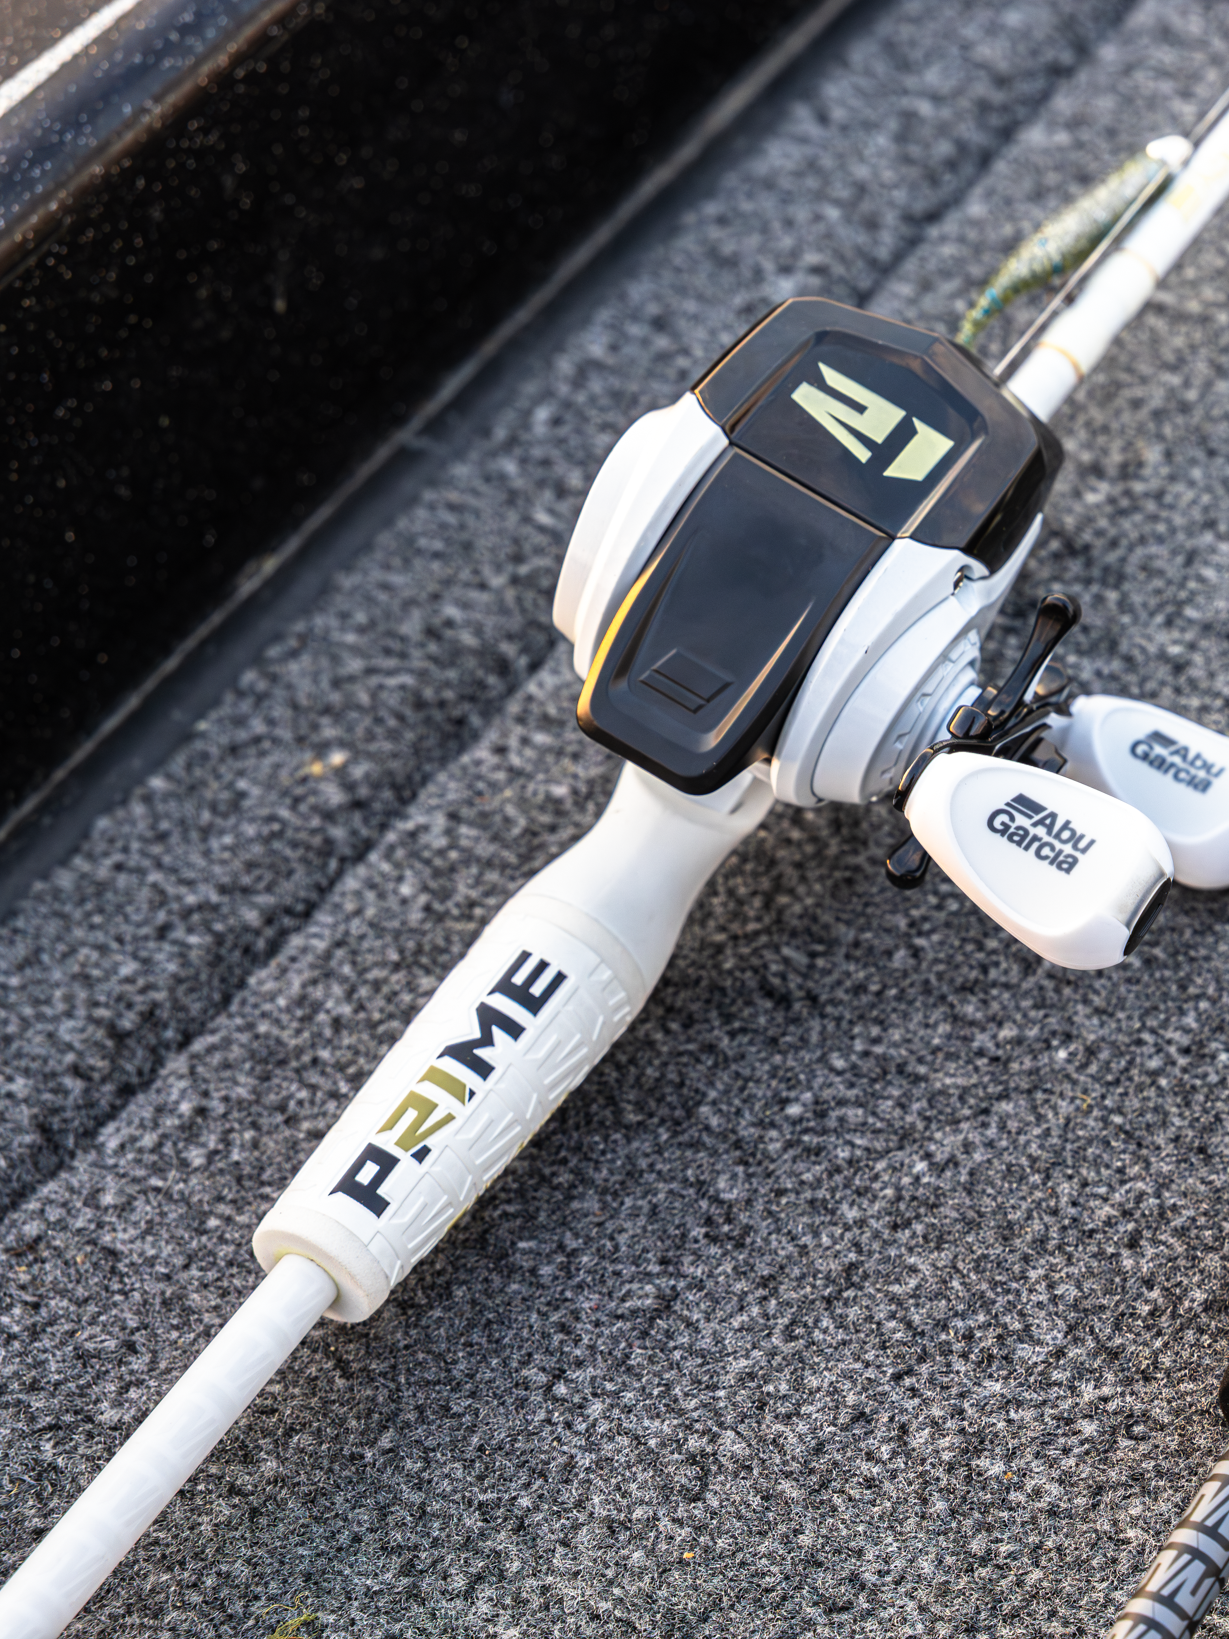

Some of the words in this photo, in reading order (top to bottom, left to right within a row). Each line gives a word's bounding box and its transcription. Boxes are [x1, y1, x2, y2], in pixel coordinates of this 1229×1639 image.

[1129, 739, 1213, 795] Garcia
[1168, 745, 1226, 778] Abu
[986, 808, 1079, 876] Garcia
[1030, 810, 1097, 855] Abu
